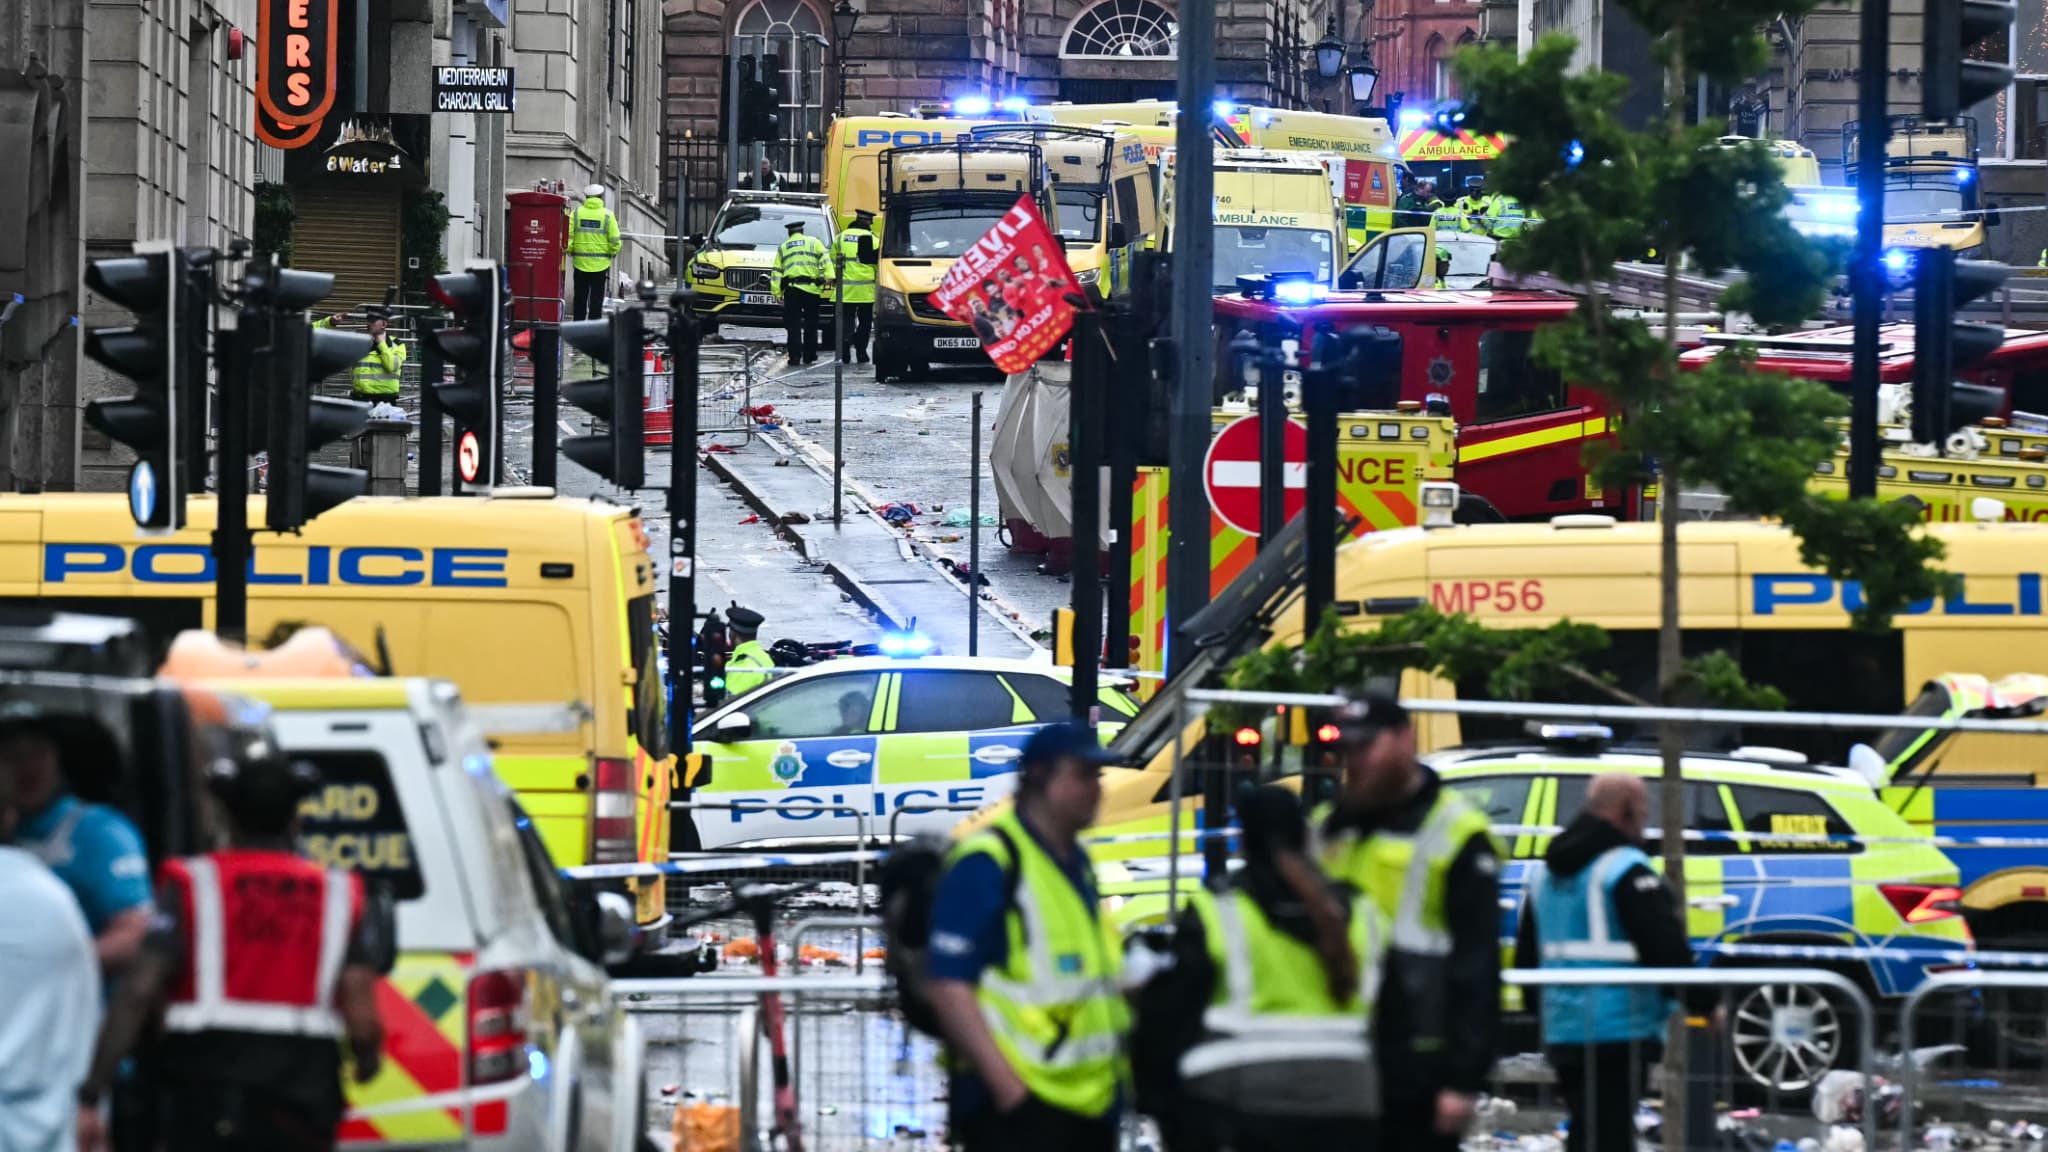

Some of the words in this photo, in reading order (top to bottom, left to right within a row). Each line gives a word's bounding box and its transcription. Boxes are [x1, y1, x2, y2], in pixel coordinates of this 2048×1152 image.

[438, 67, 508, 86] MEDITERRANEAN
[438, 92, 483, 110] CHARCOAL
[485, 92, 509, 110] GRILL
[1288, 136, 1329, 150] EMERGENCY
[1331, 142, 1372, 154] AMBULANCE
[1418, 145, 1490, 156] AMBULANCE
[747, 295, 765, 304] AD16
[44, 543, 508, 587] POLICE
[1432, 579, 1544, 614] MP56
[730, 787, 985, 823] POLICE
